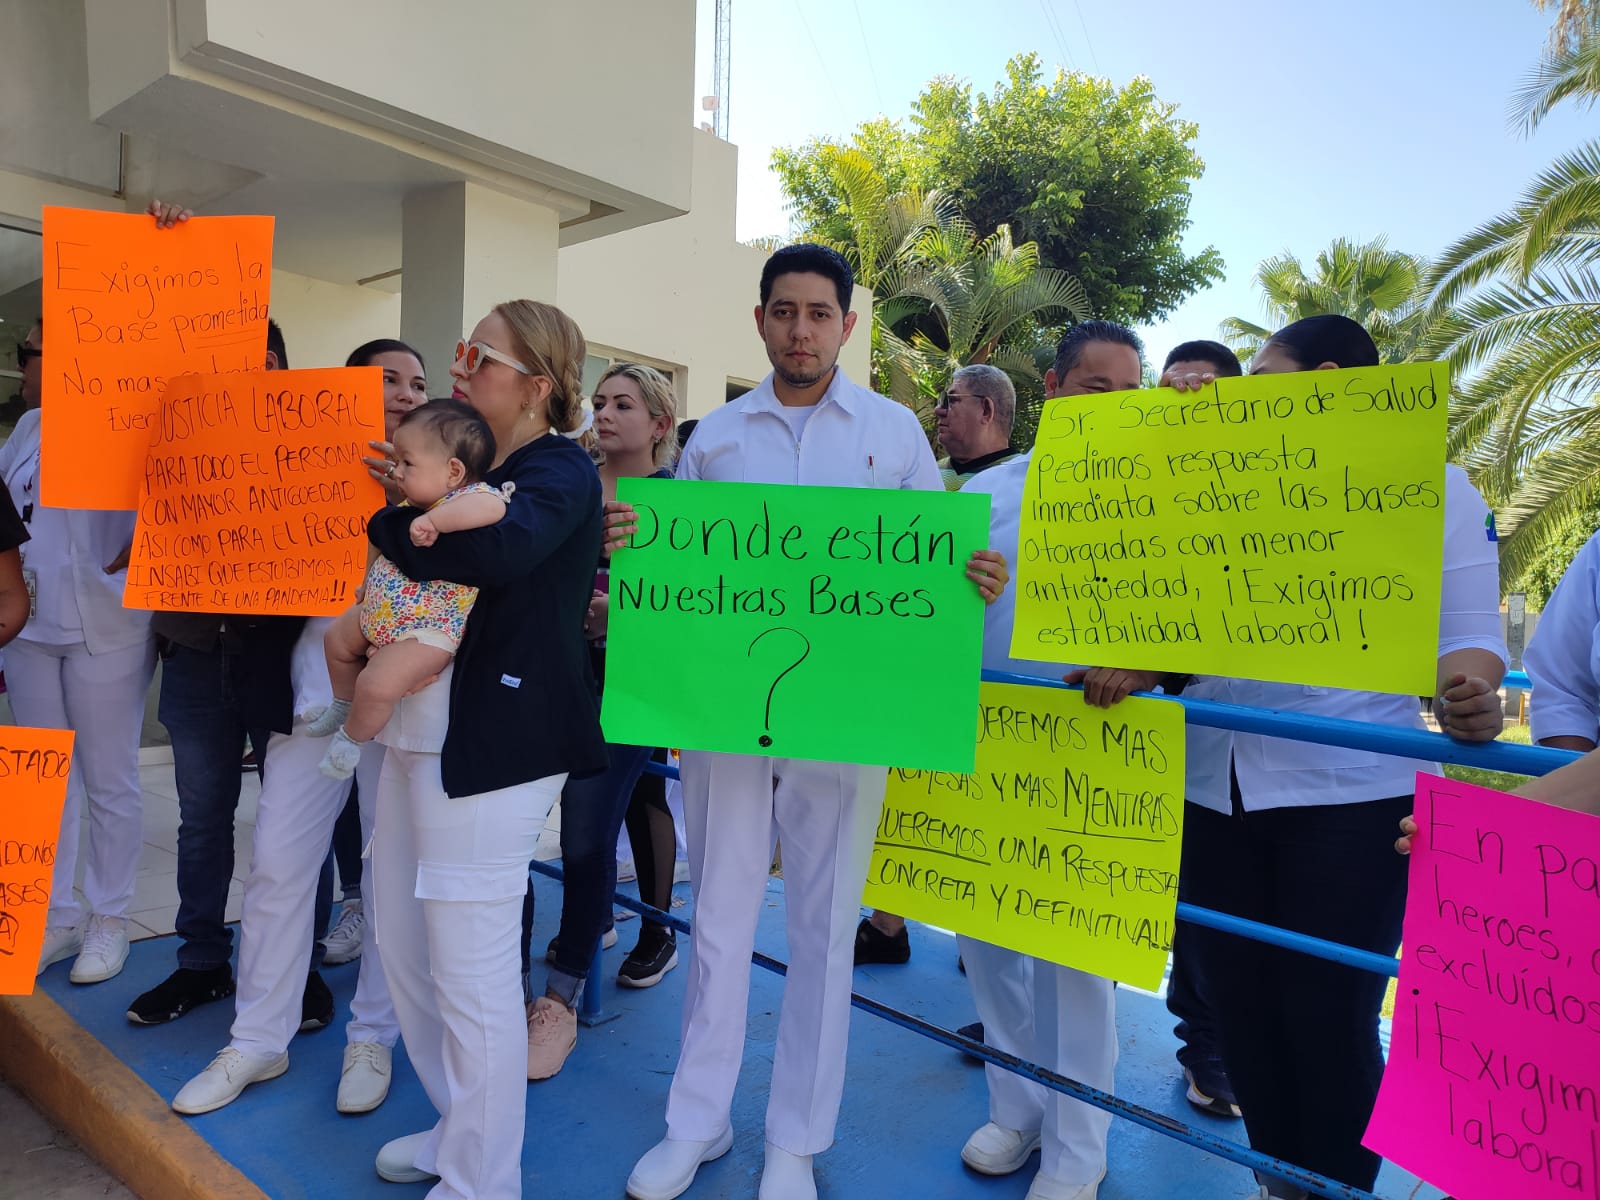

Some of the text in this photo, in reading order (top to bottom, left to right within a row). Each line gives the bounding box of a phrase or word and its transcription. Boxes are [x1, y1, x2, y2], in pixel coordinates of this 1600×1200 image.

[55, 241, 264, 319] Exigimos la
[67, 291, 269, 353] Base prometida
[64, 358, 168, 396] No mas
[1048, 368, 1438, 440] Sr. Secretario de Salud
[150, 386, 374, 447] JUSTICIA LABORAL
[146, 455, 189, 495] PARA
[192, 454, 235, 485] TODO
[240, 453, 269, 476] EL
[1167, 434, 1317, 490] respuesta
[142, 497, 178, 526] CON
[182, 488, 241, 521] MAYOR
[1174, 482, 1260, 515] sobre
[1279, 476, 1327, 511] las
[1345, 466, 1440, 514] bases
[138, 531, 168, 560] ASI
[173, 534, 211, 558] COMO
[218, 525, 265, 556] PARA
[273, 521, 299, 550] EL
[623, 500, 955, 565] Donde están
[1177, 533, 1226, 558] con
[1241, 528, 1344, 560] menor
[128, 564, 201, 588] INSABI
[208, 560, 246, 585] QUE
[248, 558, 336, 583] ESTUBIMOS
[143, 590, 204, 608] FRENTE
[210, 590, 230, 607] DE
[235, 591, 260, 608] UNA
[619, 574, 936, 618] Nuestras Bases
[1037, 606, 1200, 646] estabilidad
[747, 626, 811, 748] ?
[1101, 720, 1168, 774] MAS
[991, 772, 1006, 802] Y
[1014, 772, 1057, 808] MAS
[1064, 767, 1178, 837] MENTIRAS
[1430, 789, 1503, 874] En
[999, 836, 1051, 873] UNA
[1062, 844, 1179, 898] RESPUESTA
[990, 883, 1008, 923] Y
[1449, 1082, 1600, 1200] laboral
